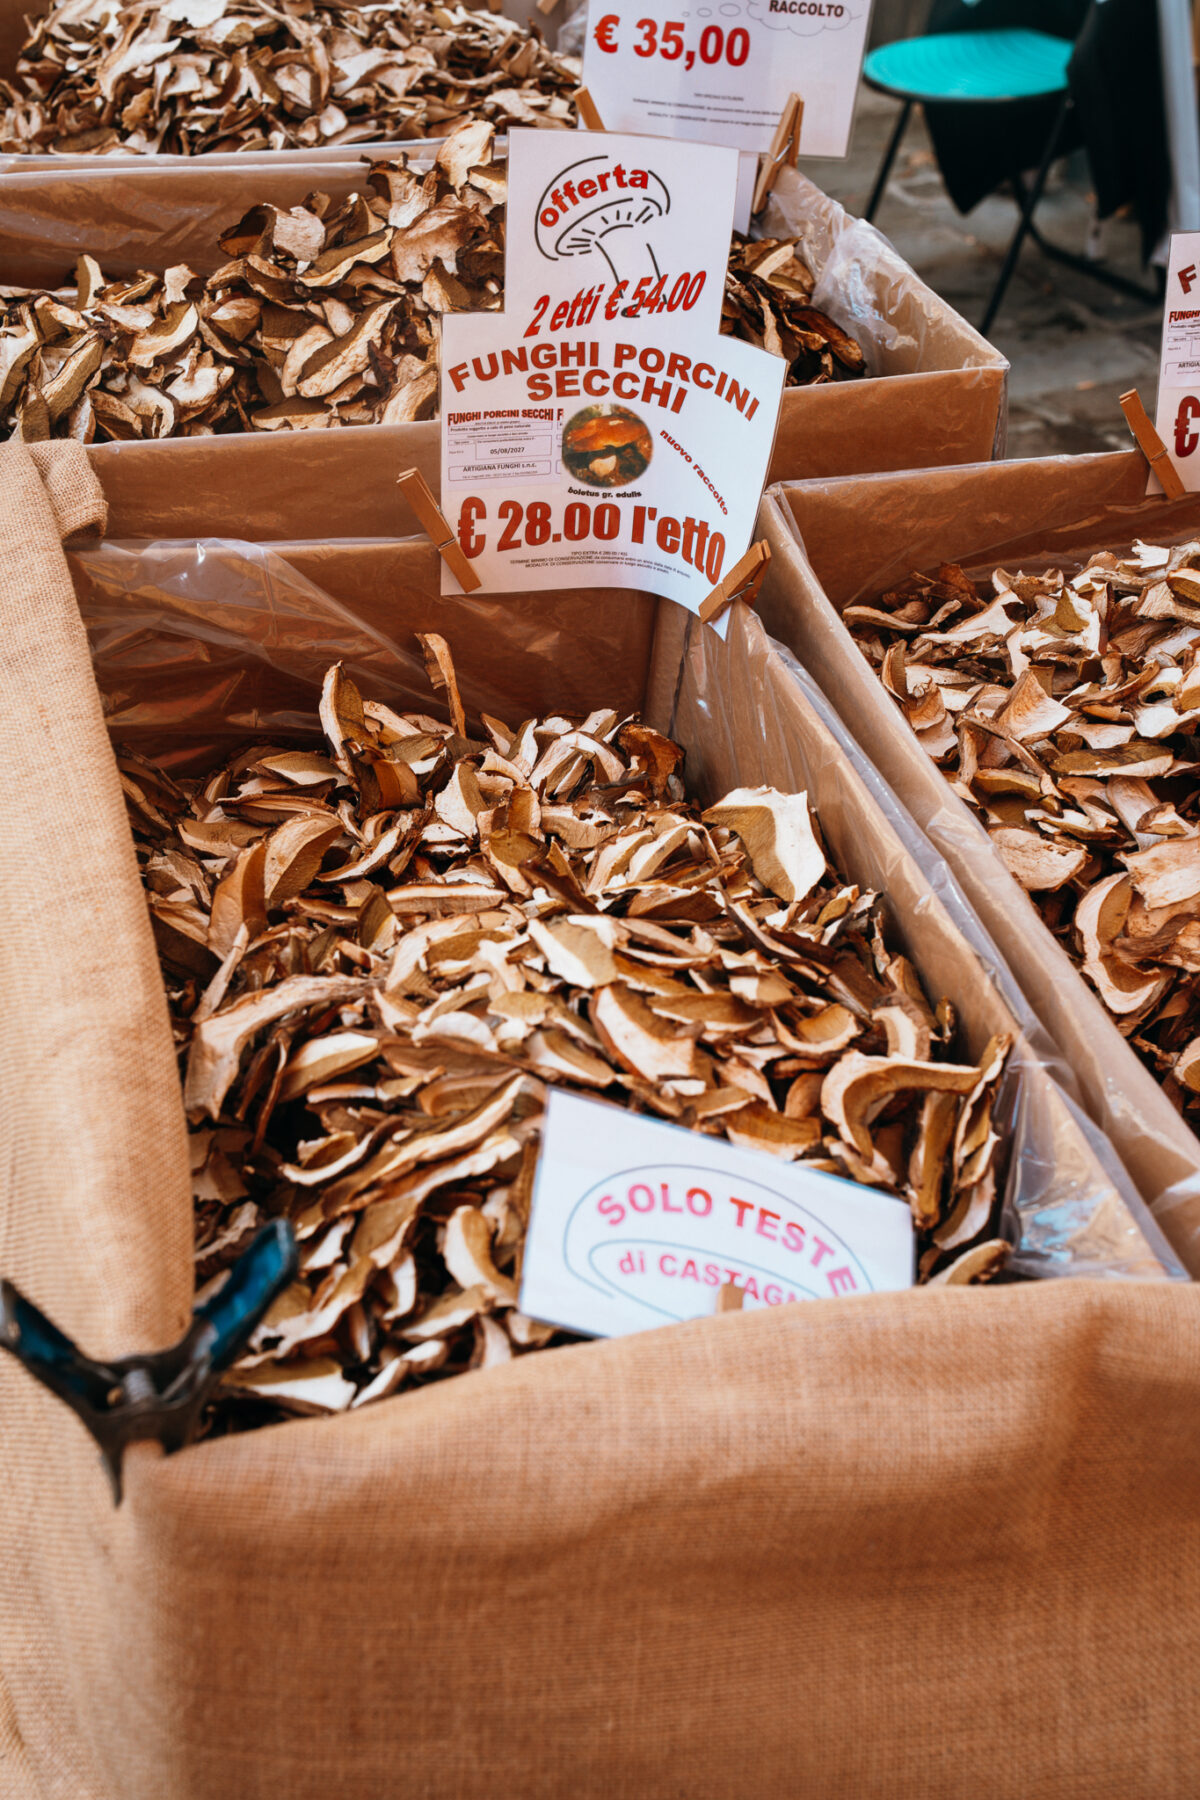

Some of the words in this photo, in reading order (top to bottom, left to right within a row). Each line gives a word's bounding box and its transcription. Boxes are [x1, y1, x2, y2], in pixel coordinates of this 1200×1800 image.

[769, 0, 844, 18] RACCOLTO
[593, 14, 620, 53] €
[633, 18, 751, 71] 35,00
[540, 164, 649, 227] offerta
[523, 294, 550, 338] 2
[550, 284, 605, 332] etti
[604, 279, 630, 320] €
[626, 270, 707, 318] 54.00
[448, 341, 600, 392] FUNGHI
[613, 343, 760, 422] PORCINI
[526, 368, 688, 414] SECCHI
[448, 411, 481, 427] FUNGHI
[483, 409, 519, 419] PORCINI
[521, 408, 554, 421] SECCHI
[1174, 395, 1200, 458] €
[463, 464, 496, 472] ARTIGIANA
[490, 447, 525, 455] 05/08/2027
[659, 430, 692, 463] nuovo
[693, 464, 728, 515] raccolto
[567, 486, 600, 497] boletus
[602, 491, 613, 499] gr.
[616, 490, 642, 498] edulis
[458, 496, 487, 559] €
[496, 500, 621, 552] 28.00
[597, 1182, 714, 1226] SOLO
[728, 1196, 858, 1297] TESTE
[618, 1251, 646, 1275] di
